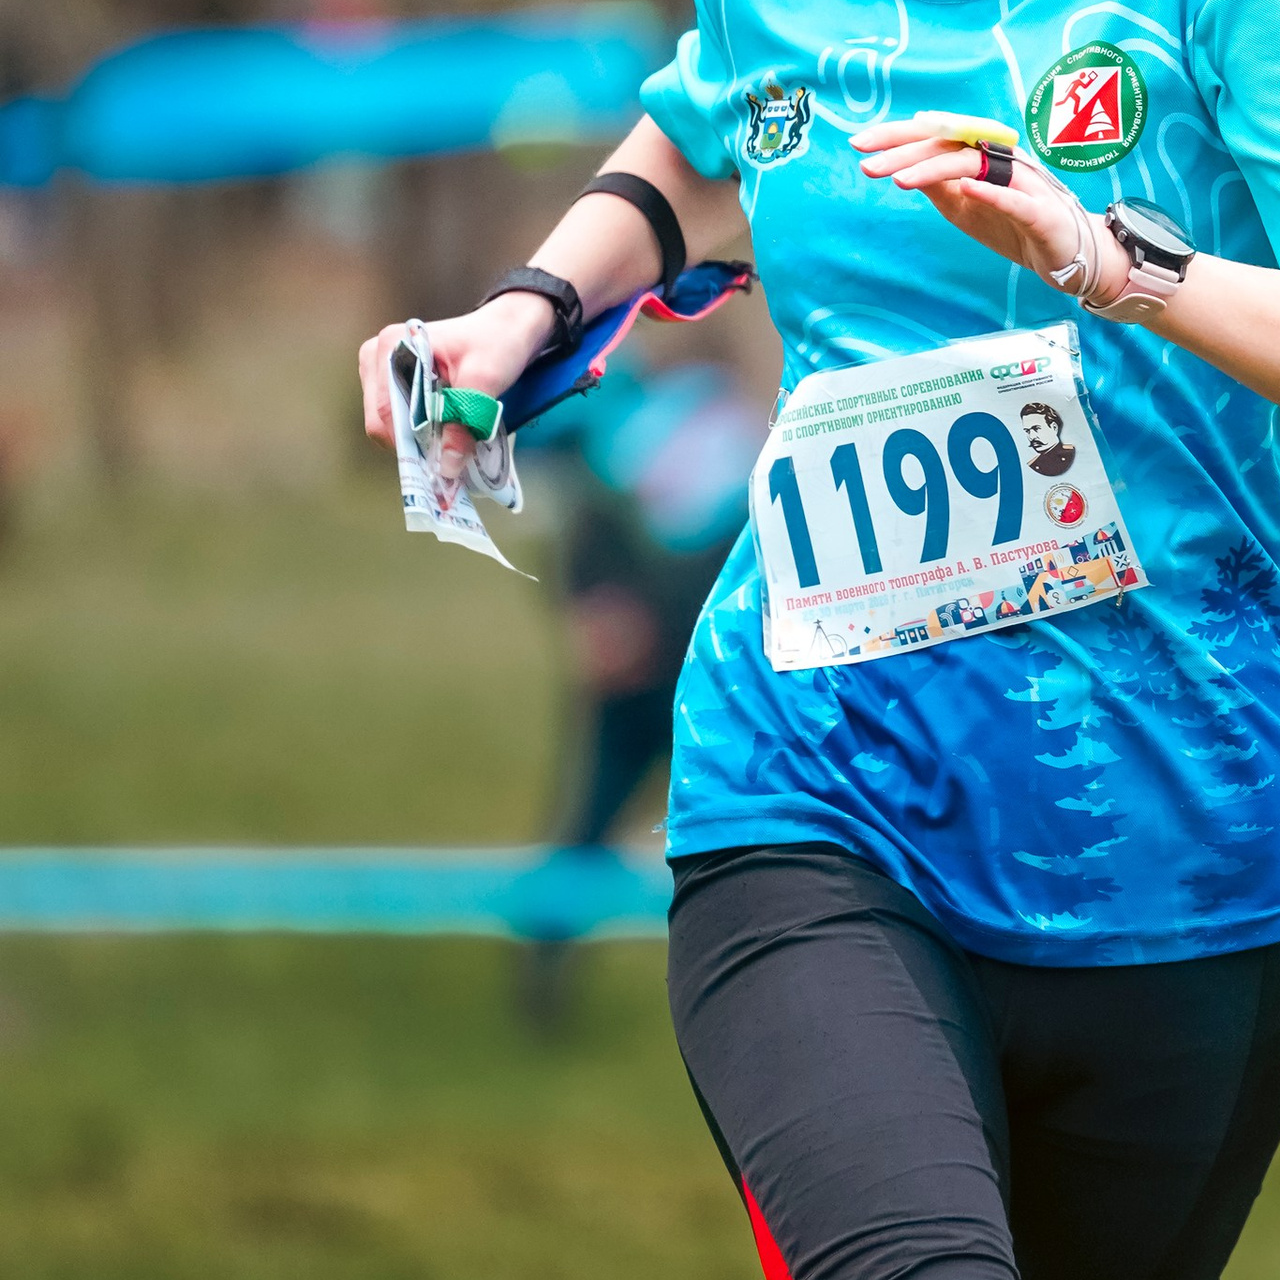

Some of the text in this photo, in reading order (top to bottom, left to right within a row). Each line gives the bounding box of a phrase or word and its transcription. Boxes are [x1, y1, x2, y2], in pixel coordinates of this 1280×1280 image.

[1031, 45, 1143, 168] ФЕДЕРАЦИЯ СПОРТИВНОГО ОРИЕНТИРОВАНИЯ ТЮМЕНСКОЙ ОБЛАСТИ
[782, 392, 963, 442] ПО СПОРТИВНОМУ ОРИЕНТИРОВАНИЮ
[836, 388, 898, 412] СПОРТИВНЫЕ
[900, 369, 985, 398] СОРЕВНОВАНИЯ
[768, 411, 1024, 589] 1199
[786, 539, 1060, 610] Памяти военного топографа А. В. Пастухова
